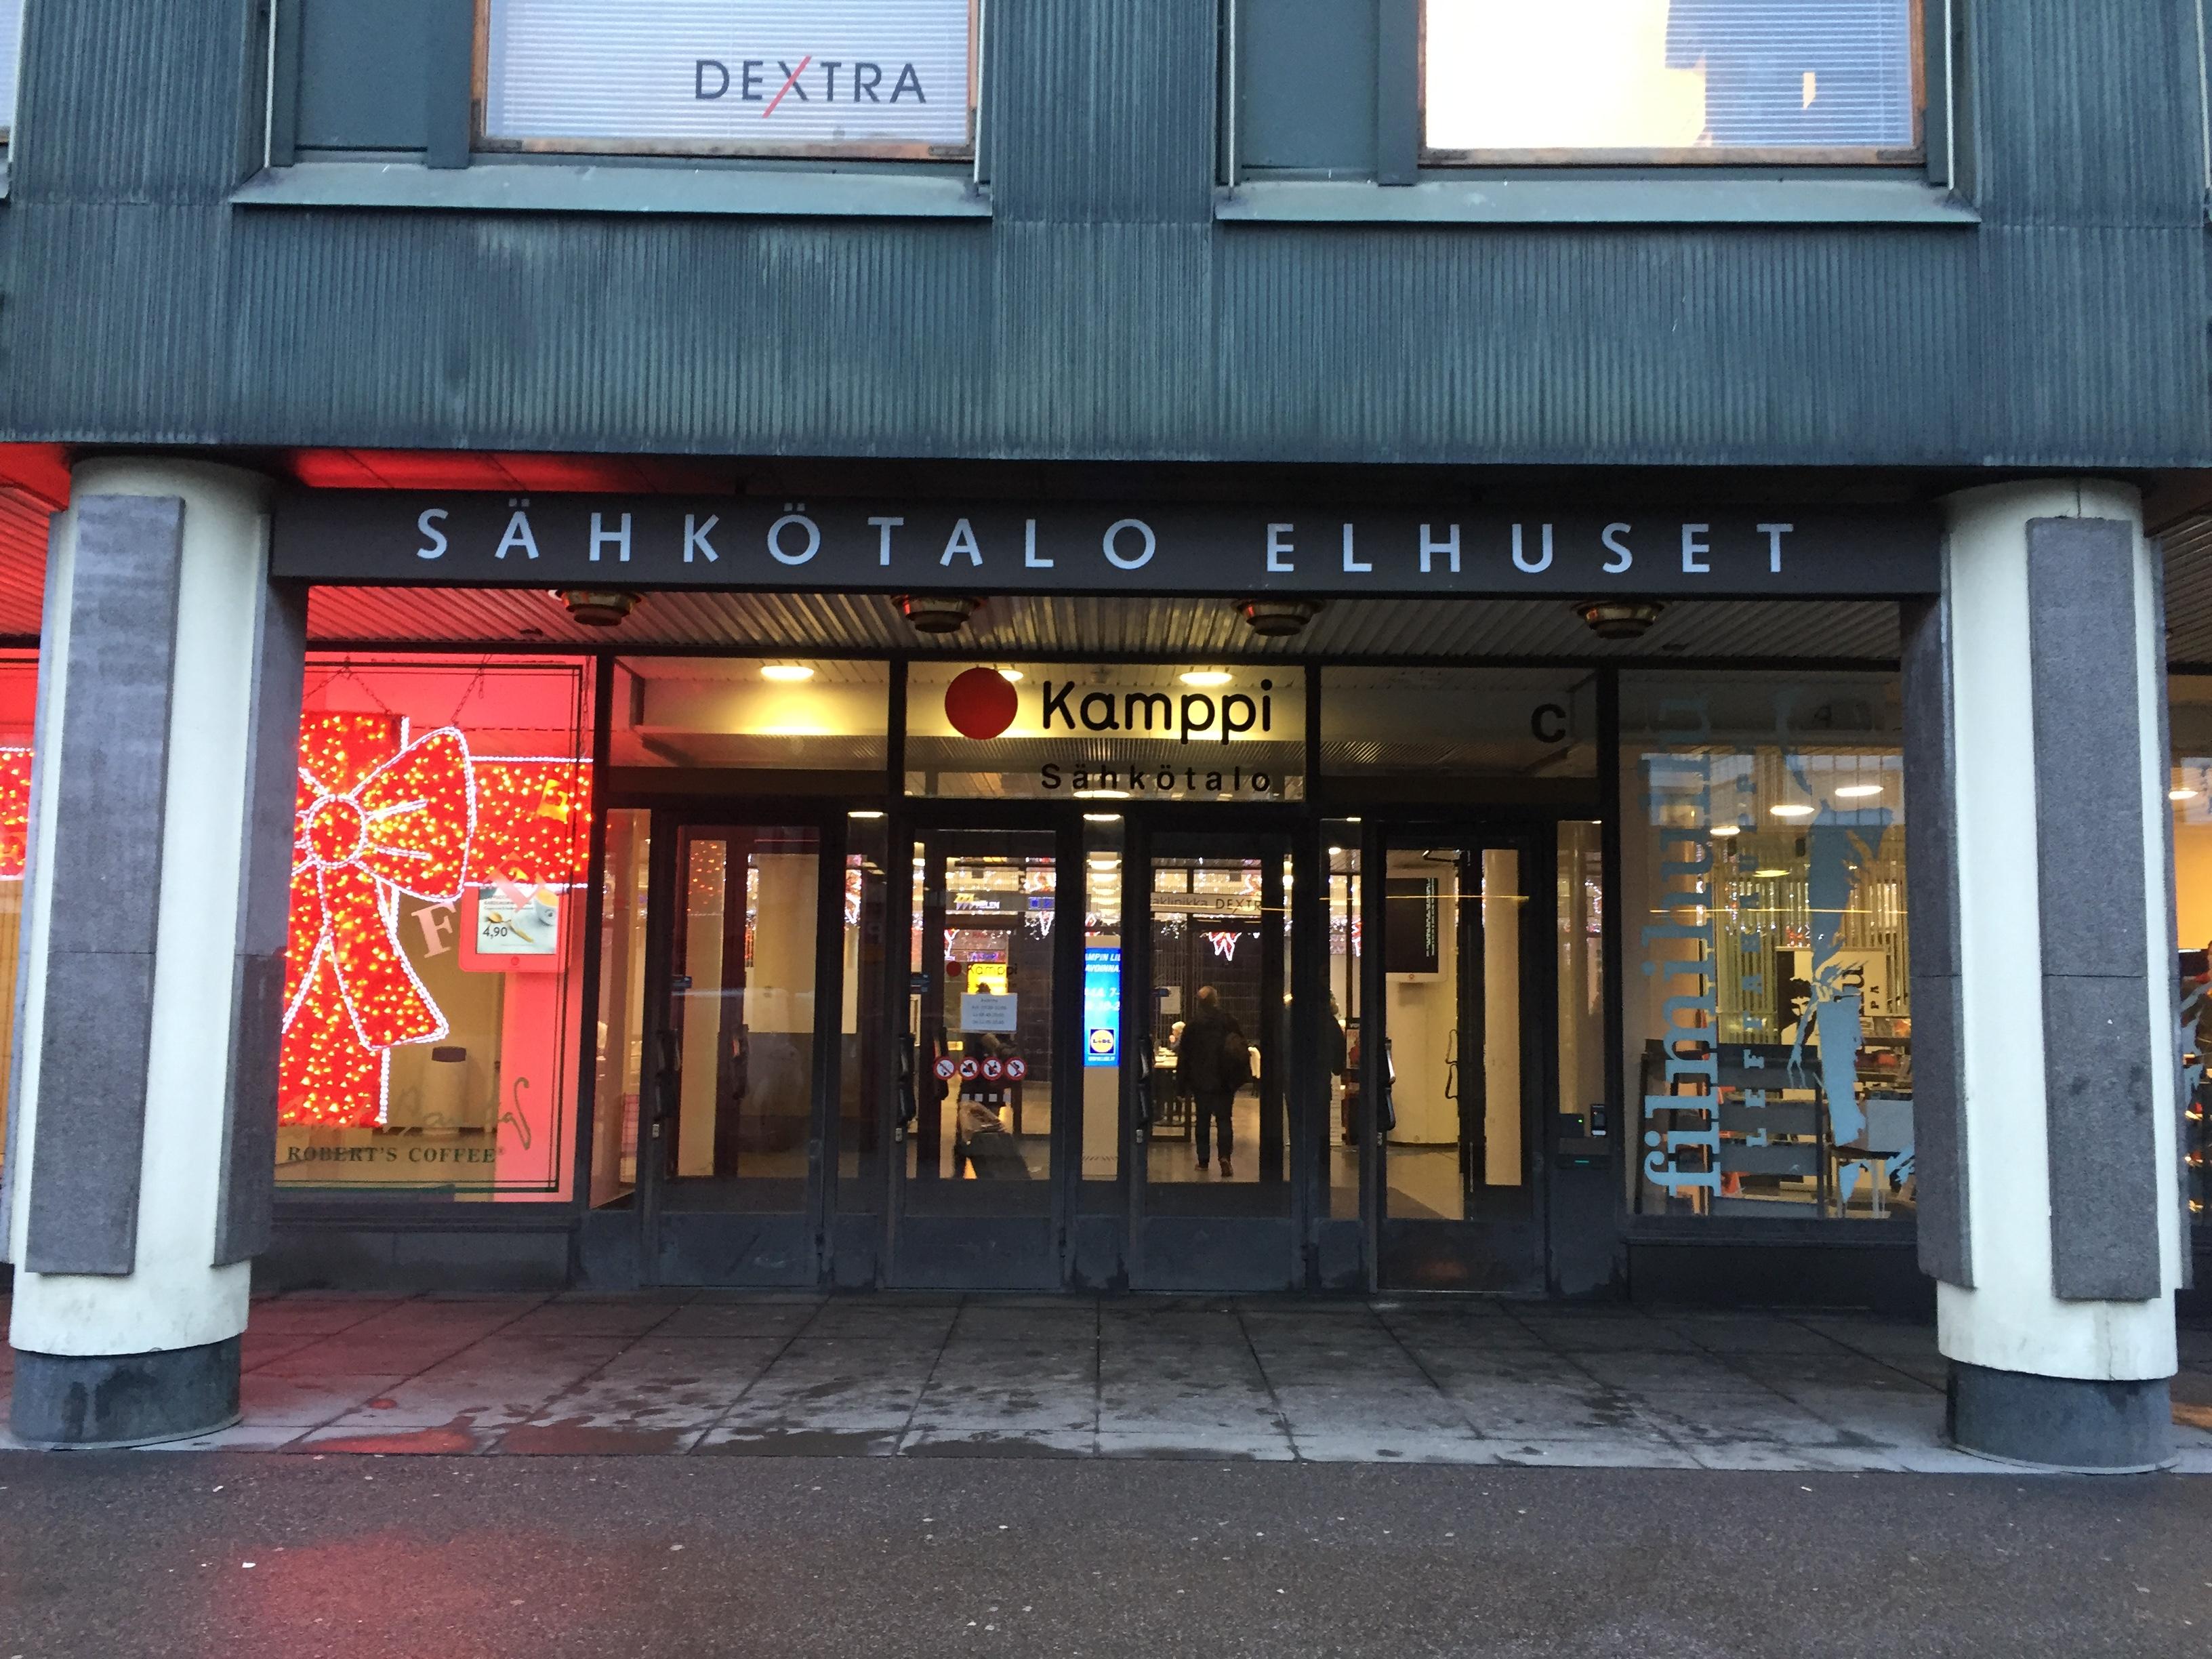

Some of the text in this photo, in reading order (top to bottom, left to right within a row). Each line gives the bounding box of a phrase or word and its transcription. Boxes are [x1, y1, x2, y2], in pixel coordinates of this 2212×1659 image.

[695, 56, 926, 119] DEXTRA
[415, 497, 1794, 574] SÄHKÖTALO ELHUSET
[1042, 678, 1273, 745] Kamppi
[1530, 703, 1568, 743] C
[1040, 762, 1271, 792] Sähkötalo
[482, 926, 508, 939] 4,90
[287, 1146, 496, 1164] ROBERT'S COFFEE
